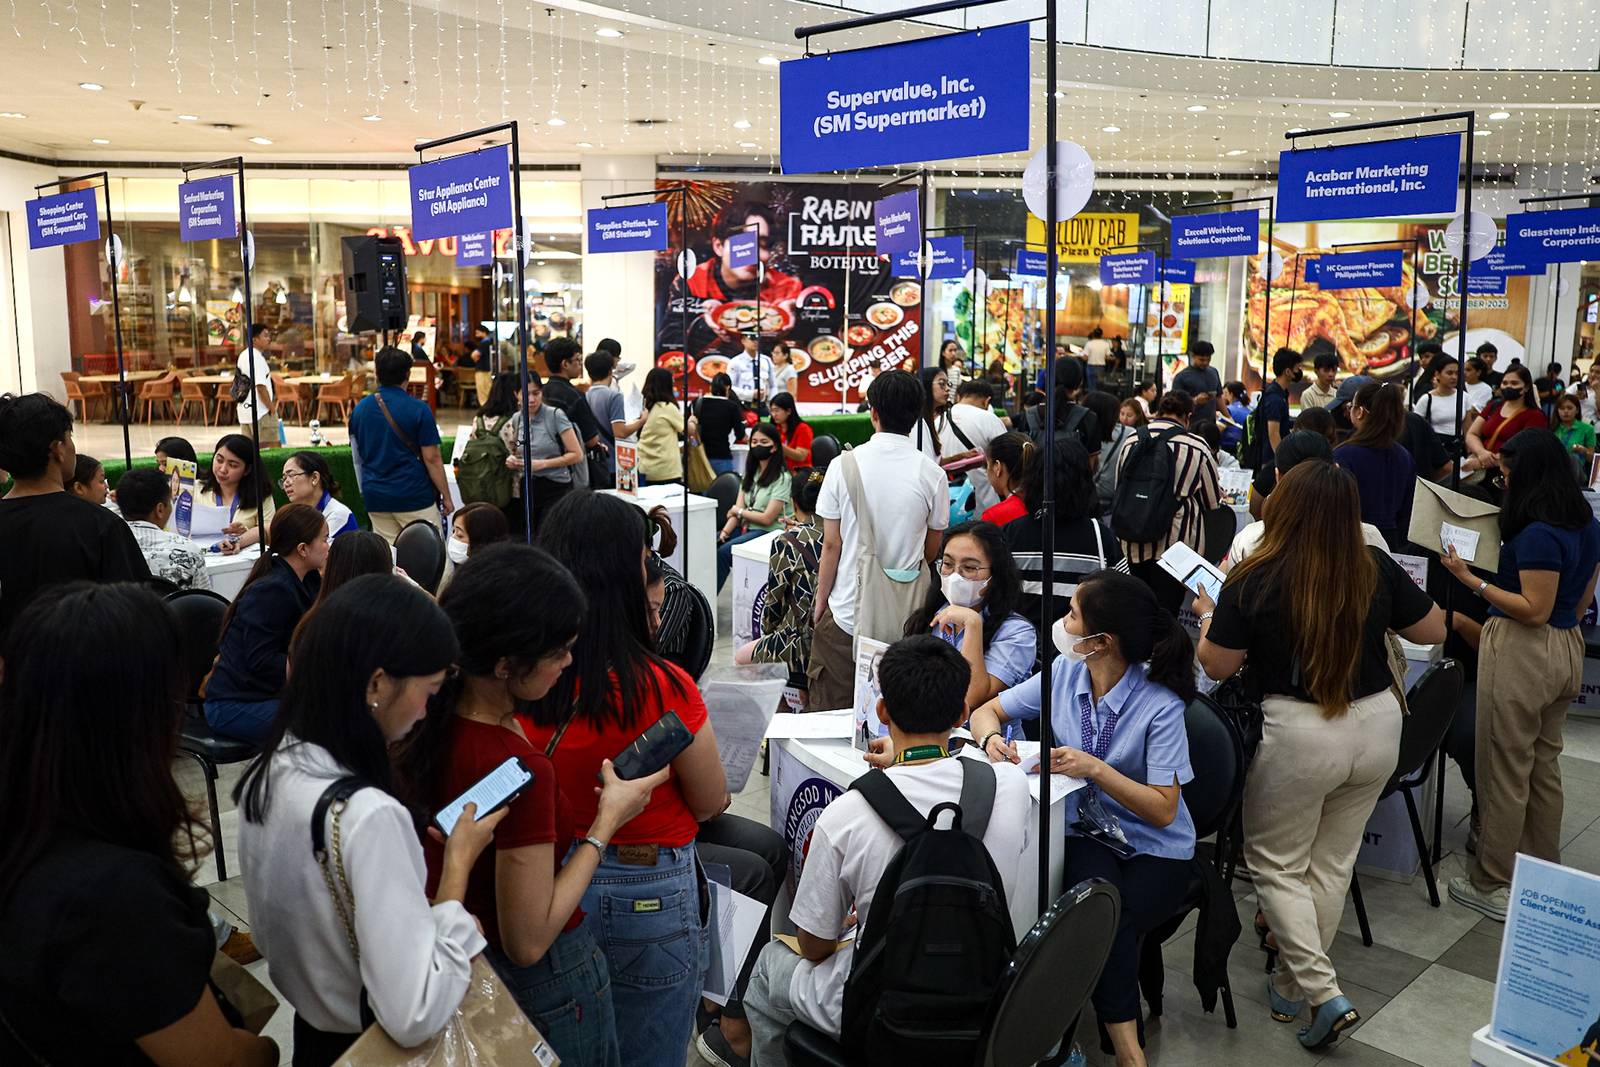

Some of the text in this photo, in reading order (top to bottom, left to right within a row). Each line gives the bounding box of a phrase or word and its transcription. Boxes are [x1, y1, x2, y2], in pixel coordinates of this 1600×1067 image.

[827, 76, 975, 111] Supervalue, Inc.
[813, 96, 986, 137] (SM Supermarket)
[1305, 163, 1428, 183] Acabar Marketing
[418, 176, 500, 201] Star Appliance Center
[1306, 179, 1425, 198] International, Inc.
[39, 202, 84, 216] Shopping Center
[430, 193, 488, 216] (SM Appliance)
[802, 196, 873, 224] RABIN
[37, 212, 88, 227] Management Corp.
[595, 221, 621, 231] Supplies
[622, 220, 647, 229] Station,
[42, 221, 86, 237] (SM Supermalls)
[602, 228, 651, 240] (SM Stationery)
[800, 224, 876, 247] RAME
[1099, 219, 1126, 246] CAB
[1208, 225, 1245, 235] Workforce
[1519, 228, 1576, 237] Glasstemp
[1177, 234, 1251, 247] Solutions Corporation
[1061, 247, 1089, 256] Pizza
[810, 256, 879, 271] BOTEJYU
[1337, 263, 1367, 271] Consumer
[1335, 271, 1371, 279] Philippines,
[1434, 300, 1507, 308] SEPTEBER 2025
[883, 320, 919, 350] THIS
[1521, 888, 1586, 914] JOB OPENING
[1520, 898, 1547, 912] Client
[1549, 906, 1583, 924] Service
